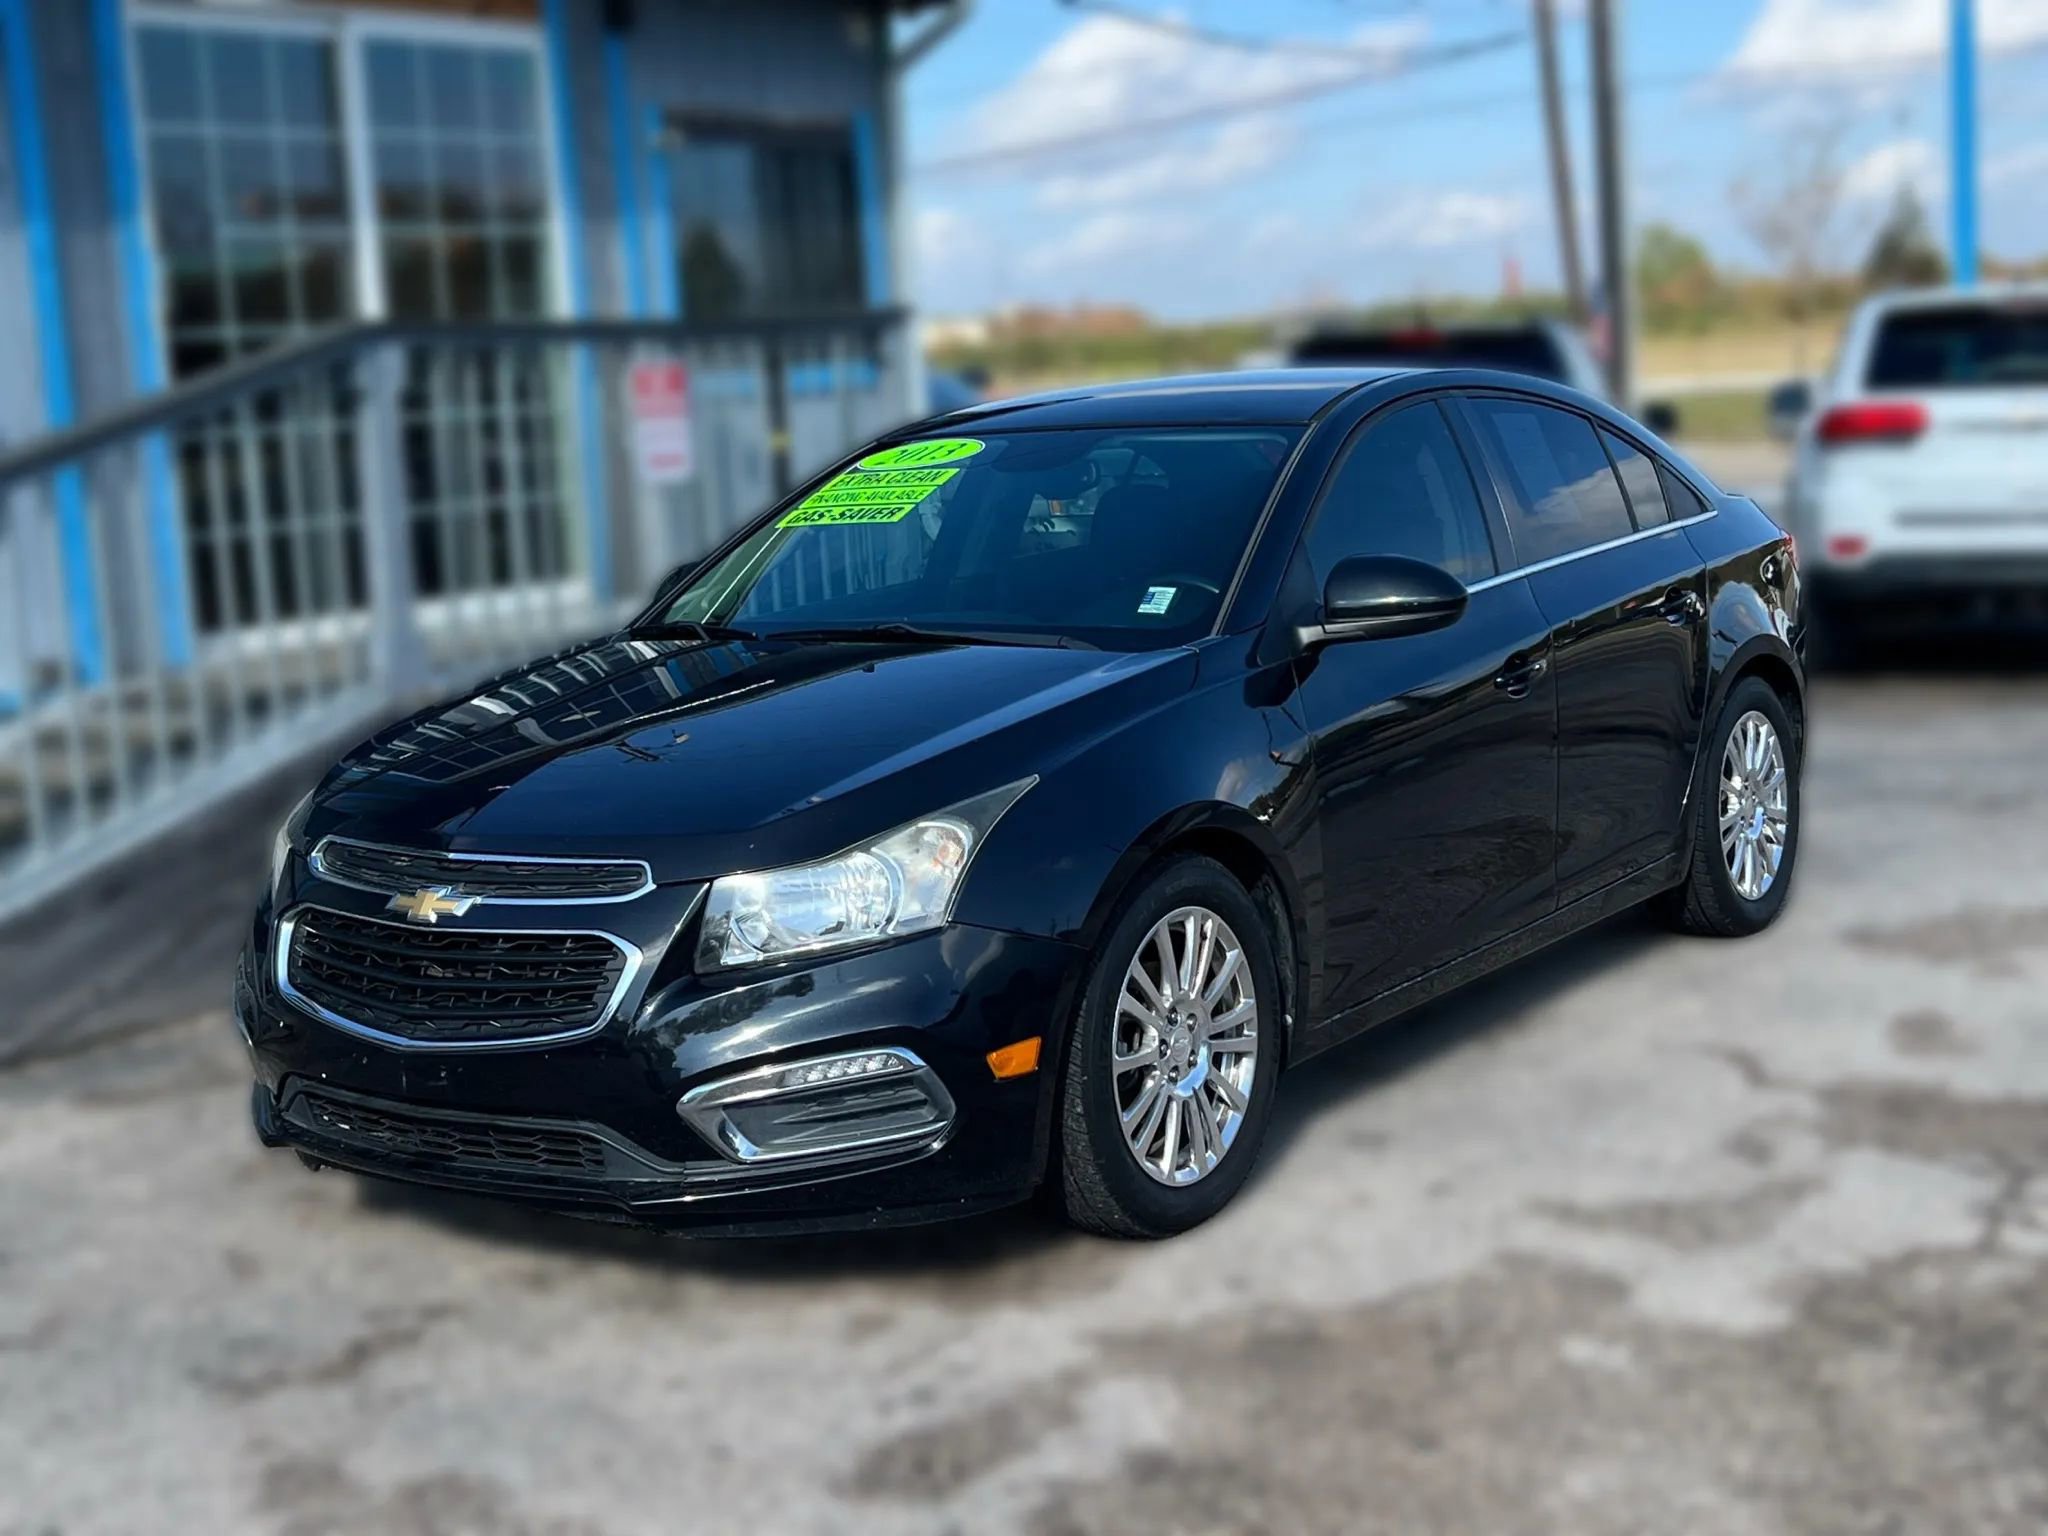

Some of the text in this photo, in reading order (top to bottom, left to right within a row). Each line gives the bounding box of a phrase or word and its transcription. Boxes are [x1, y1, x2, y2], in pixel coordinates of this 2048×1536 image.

[832, 470, 945, 488] EXTRA CLEAN
[864, 489, 929, 503] AVAILABLE
[786, 507, 904, 524] GAS-SAVER
